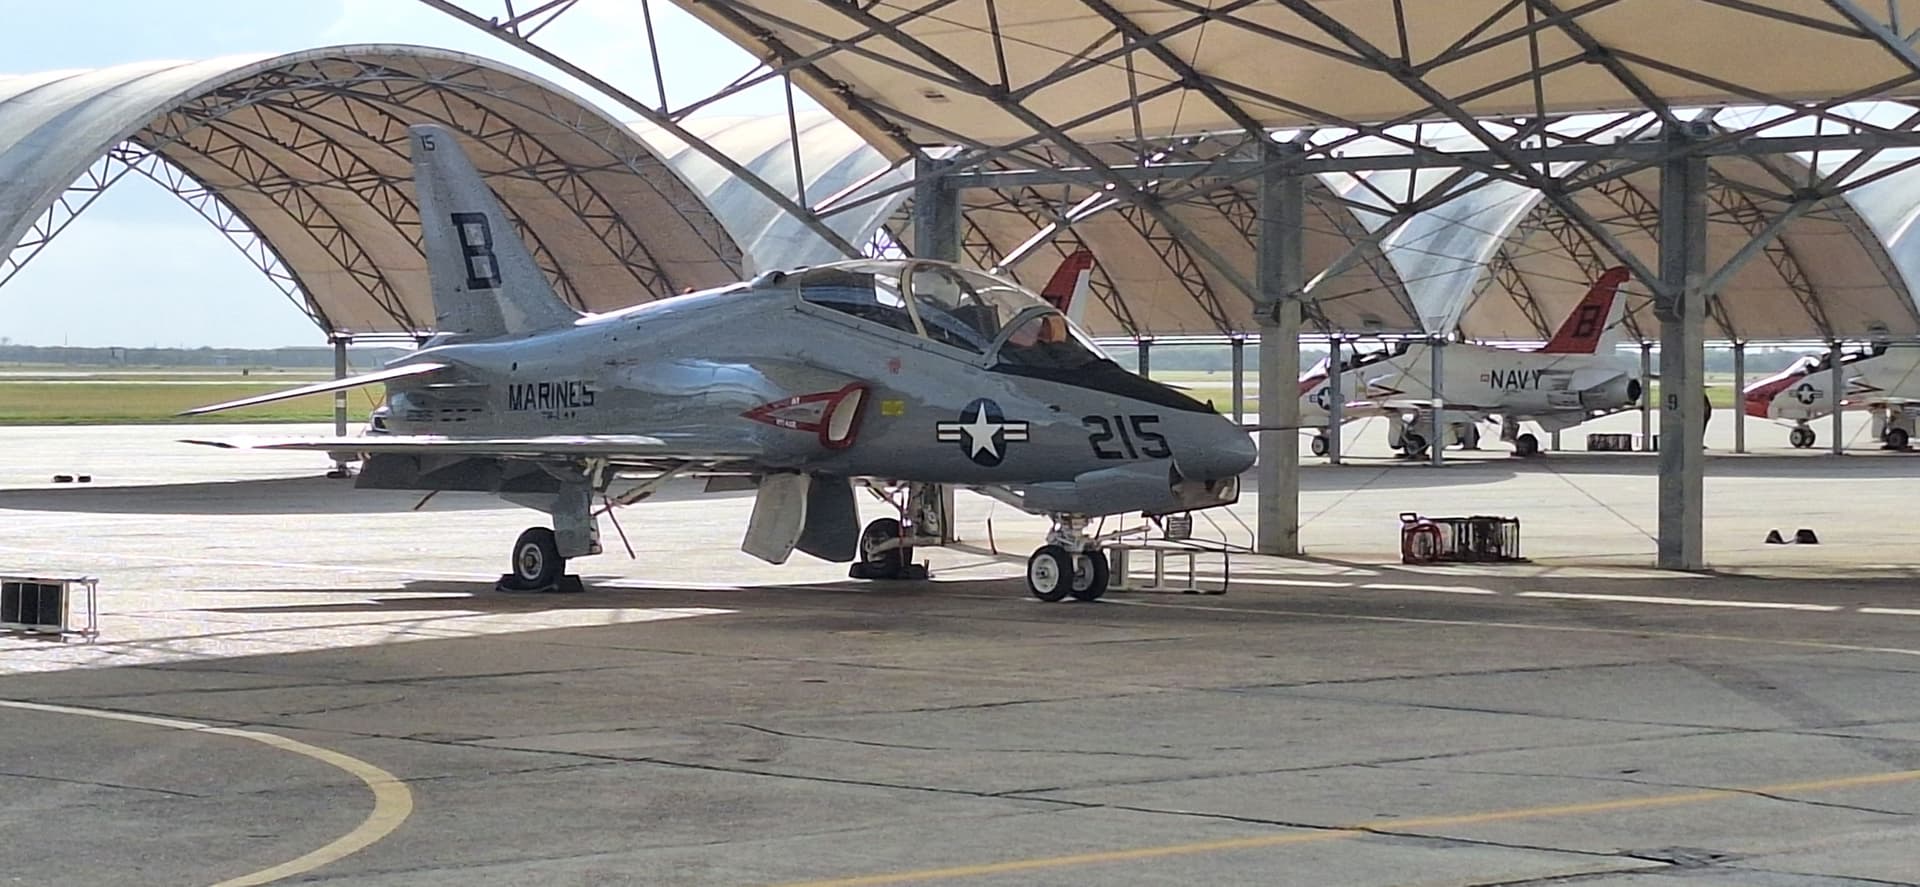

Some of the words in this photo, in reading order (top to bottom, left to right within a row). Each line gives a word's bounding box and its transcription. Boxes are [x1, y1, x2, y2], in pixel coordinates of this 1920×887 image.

[421, 135, 435, 151] 15
[451, 212, 502, 290] B
[1571, 305, 1601, 338] B
[1490, 369, 1543, 390] NAVY
[509, 380, 594, 410] MARINES
[1668, 394, 1678, 411] 9
[1082, 415, 1172, 460] 215
